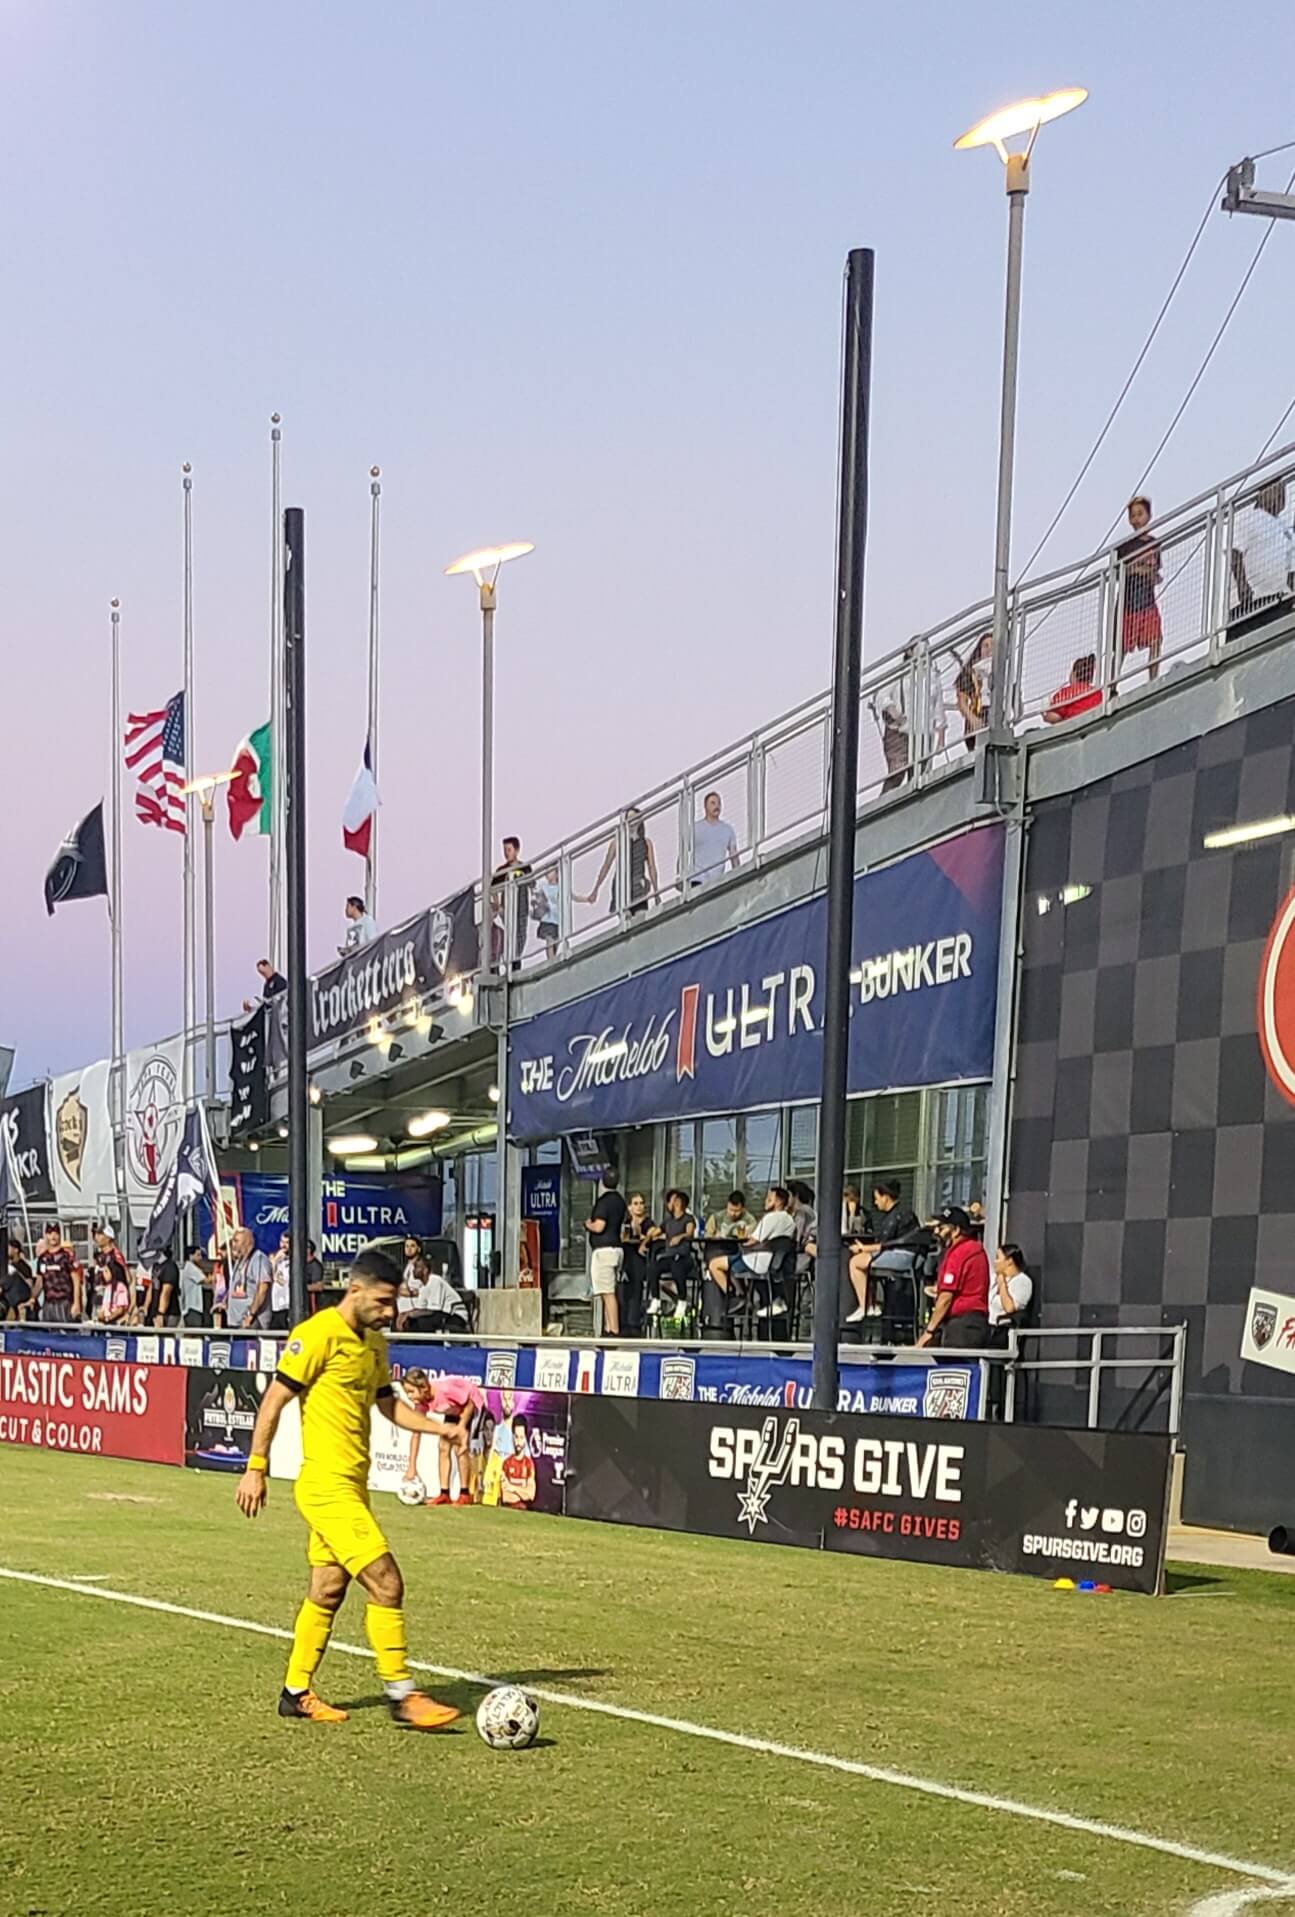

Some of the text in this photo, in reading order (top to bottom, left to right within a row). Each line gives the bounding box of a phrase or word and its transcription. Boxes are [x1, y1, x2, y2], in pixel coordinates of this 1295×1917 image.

[521, 934, 972, 1101] THE Michelob ULTR BUNKER
[320, 1180, 345, 1197] THE
[530, 1192, 557, 1208] ULTRA
[341, 1206, 408, 1224] ULTRA
[697, 1383, 917, 1413] THE Michelob URA BUNKER
[0, 1416, 102, 1451] CUT & COLOR
[709, 1416, 964, 1508] SPURS GIVE
[834, 1507, 960, 1540] #SAFC GIVES
[1022, 1534, 1144, 1567] SPURSGIVE.ORG
